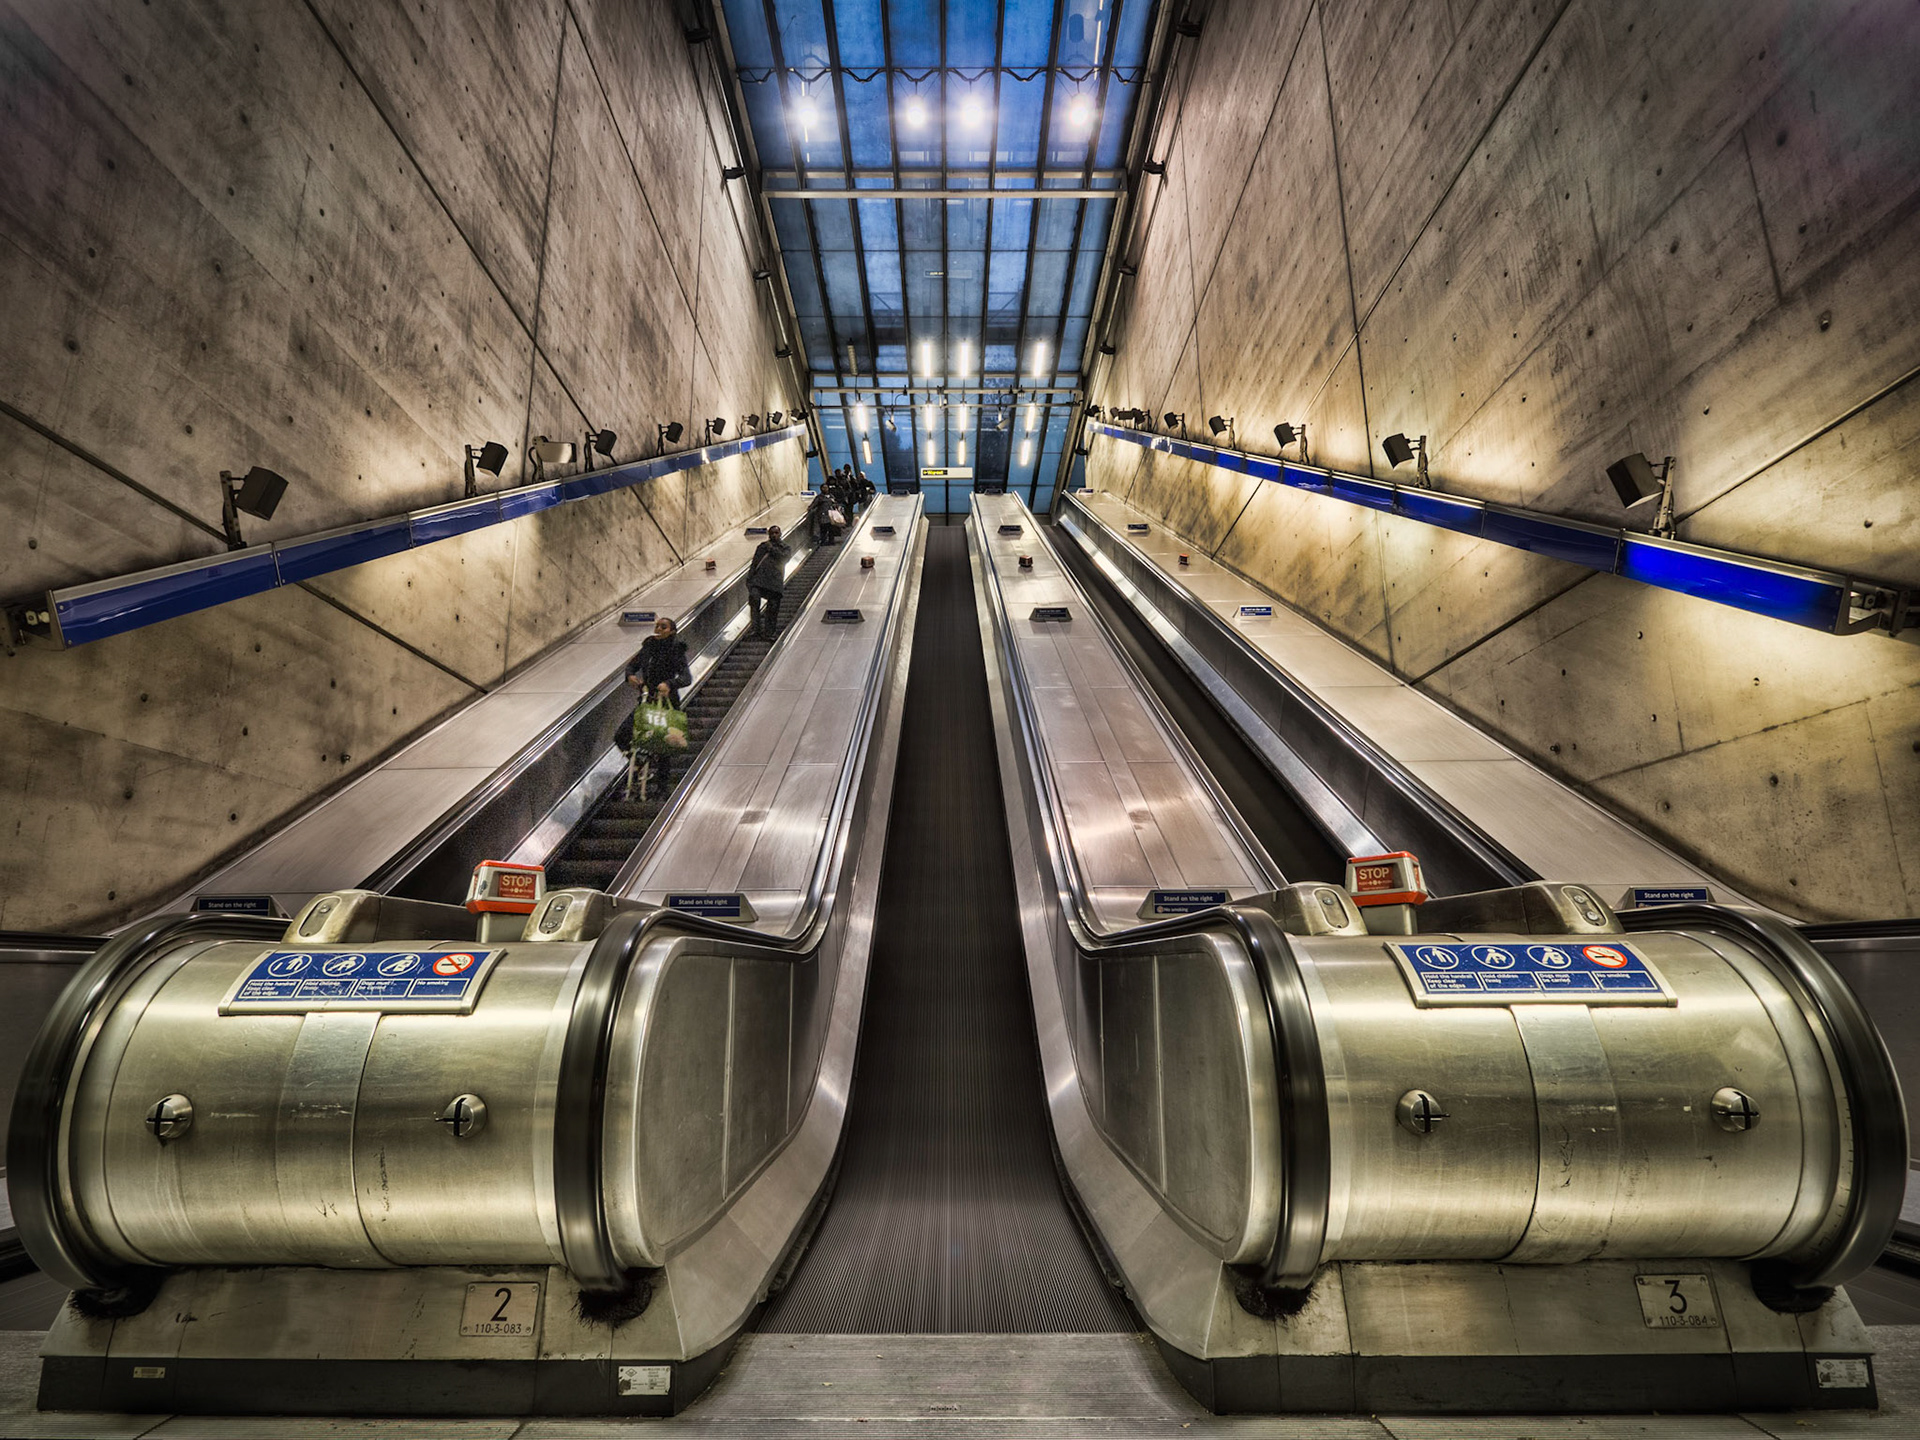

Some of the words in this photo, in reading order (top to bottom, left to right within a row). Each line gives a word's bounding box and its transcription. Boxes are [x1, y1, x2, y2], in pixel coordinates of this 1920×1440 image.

[1359, 867, 1389, 880] STOP
[502, 874, 532, 887] STOP
[1664, 1280, 1688, 1314] 3
[490, 1287, 512, 1322] 2
[1659, 1315, 1708, 1326] 110-3-084
[475, 1323, 522, 1334] 110-3-083
